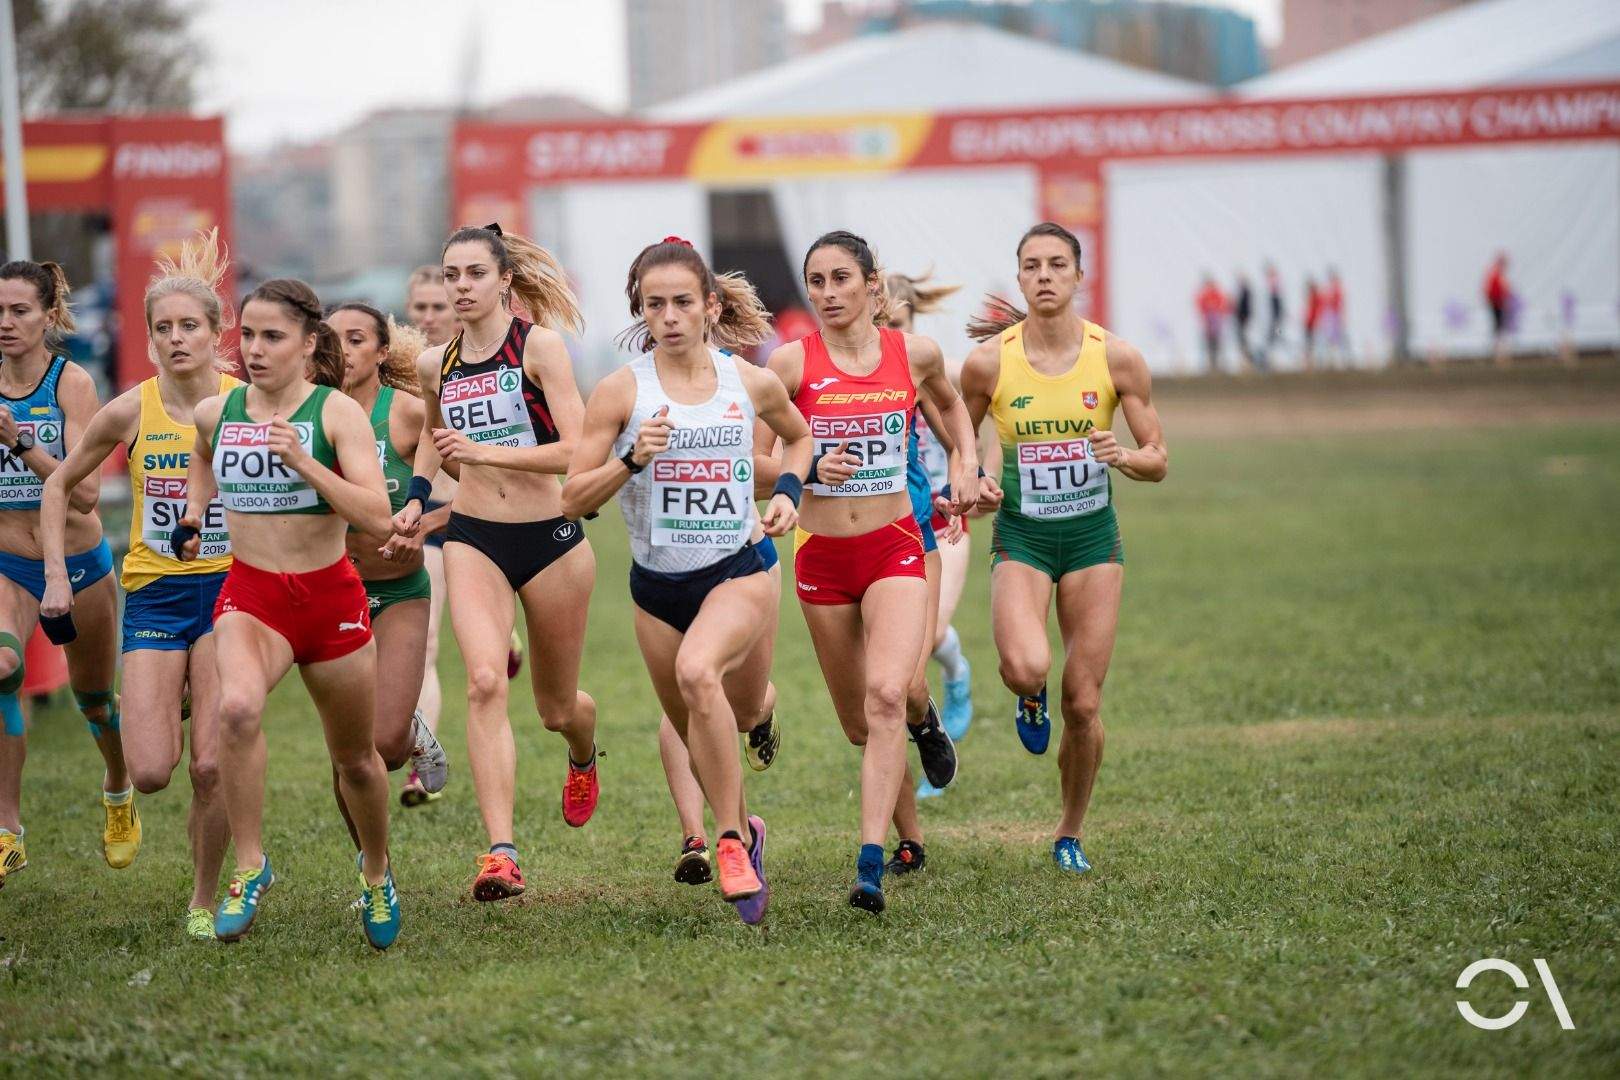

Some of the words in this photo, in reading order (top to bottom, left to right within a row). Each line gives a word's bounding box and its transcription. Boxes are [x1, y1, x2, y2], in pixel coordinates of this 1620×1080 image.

[951, 113, 1150, 160] EUROPEAN
[1152, 108, 1278, 151] CROSS
[1280, 99, 1463, 147] COUNTRY
[527, 131, 675, 174] START
[443, 376, 497, 401] SPAR
[815, 388, 908, 405] ESPAÑA
[514, 403, 521, 411] 1
[1009, 396, 1034, 409] 4F
[448, 399, 508, 431] BEL
[481, 427, 510, 440] CLEAN
[813, 418, 881, 437] SPAR
[1015, 420, 1094, 436] LIETUVA
[146, 433, 174, 441] CRAFT
[668, 425, 743, 450] FRANCE
[1021, 442, 1085, 462] SPAR
[220, 450, 290, 478] POR
[656, 462, 730, 480] SPAR
[857, 469, 886, 479] CLEAN
[1029, 464, 1089, 491] LTU
[236, 484, 257, 493] RUN
[258, 483, 289, 493] CLEAN
[870, 480, 893, 492] 2019
[232, 497, 271, 507] LISBOA
[272, 495, 299, 508] 2019
[662, 486, 737, 515] FRA
[1044, 493, 1063, 503] RUN
[1064, 490, 1091, 502] CLEAN
[1038, 505, 1075, 515] LISBOA
[1076, 498, 1096, 511] 2019
[678, 520, 700, 529] RUN
[701, 520, 735, 530] CLEAN
[671, 533, 713, 545] LISBOA
[203, 545, 227, 555] 2019
[134, 630, 168, 639] CRAFT
